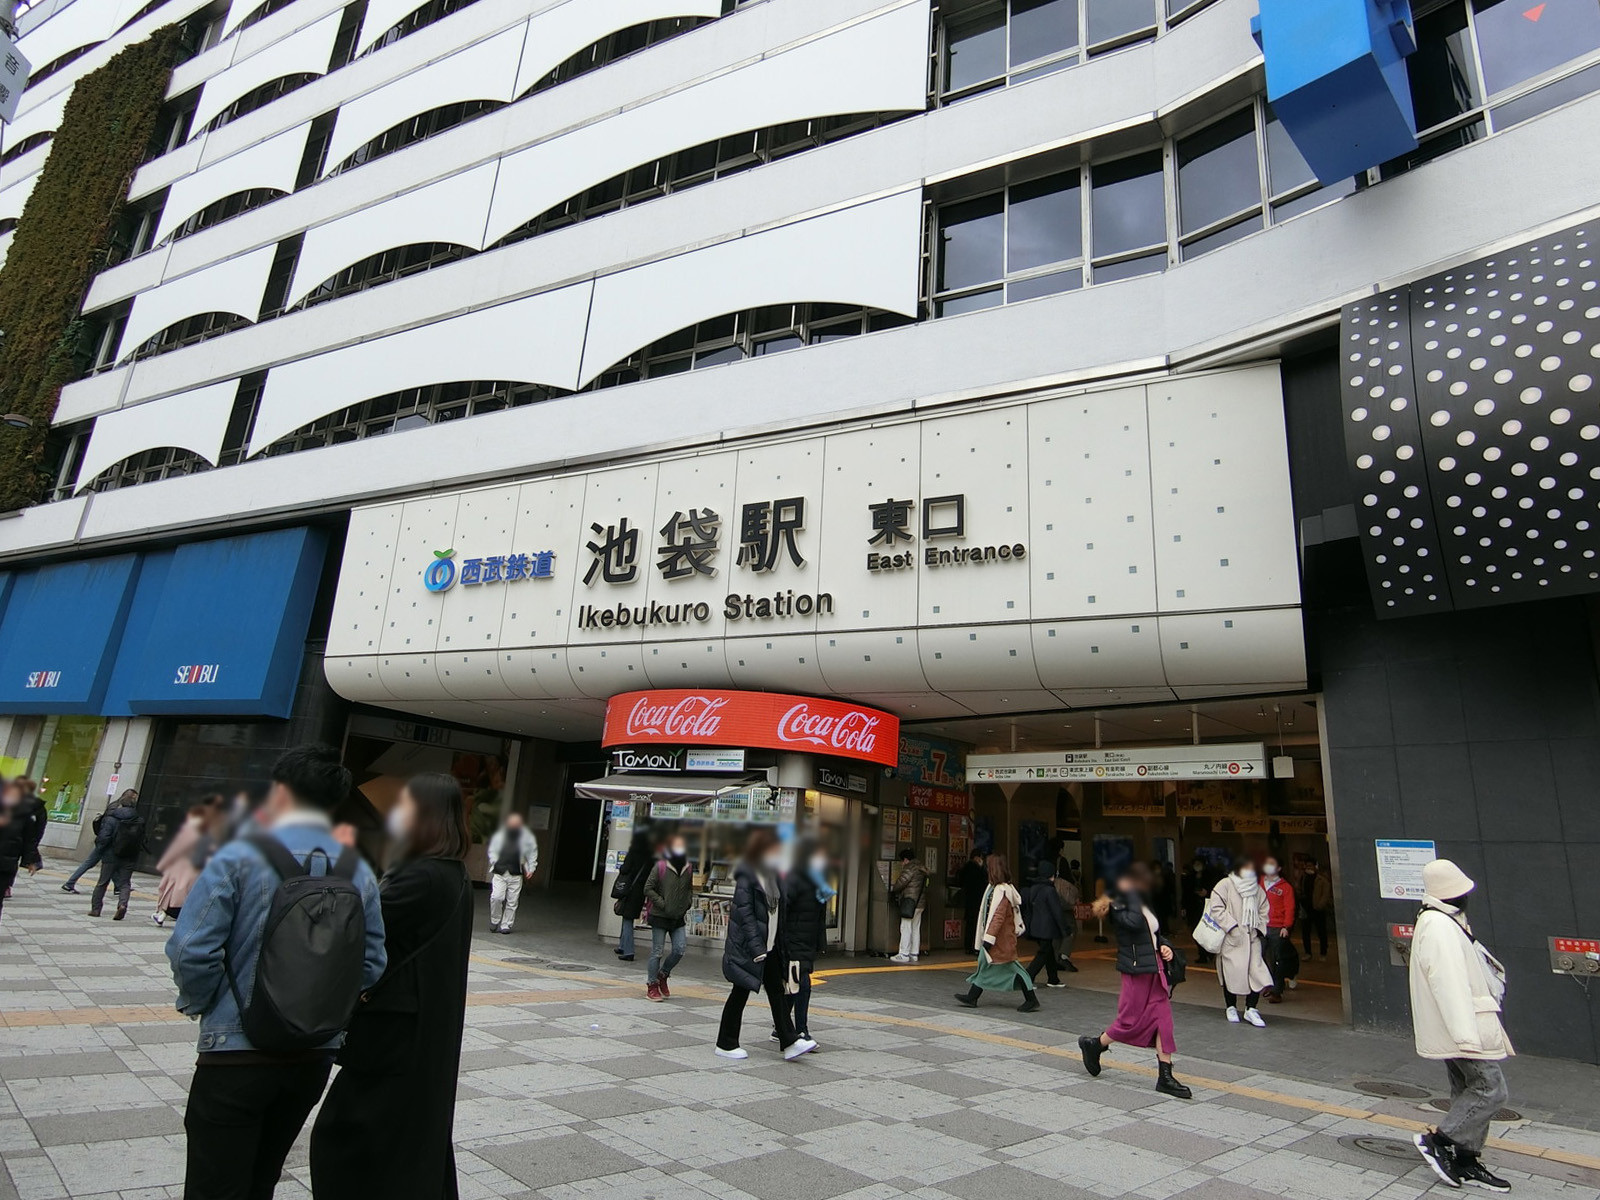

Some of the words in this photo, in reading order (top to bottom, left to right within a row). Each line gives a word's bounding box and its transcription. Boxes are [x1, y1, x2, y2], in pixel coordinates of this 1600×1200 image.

[867, 493, 966, 546] 東口
[581, 496, 807, 587] 池袋駅
[867, 552, 912, 571] East
[924, 542, 1026, 567] Entrance
[459, 549, 556, 585] 西武鉄道
[578, 599, 710, 630] Ikebukuro
[723, 589, 834, 621] Station
[26, 670, 62, 688] SEIBU
[174, 664, 220, 685] SEIBU
[393, 721, 452, 745] SEIBU
[626, 696, 731, 737] Coca-Cola
[777, 703, 880, 753] Coca-Cola
